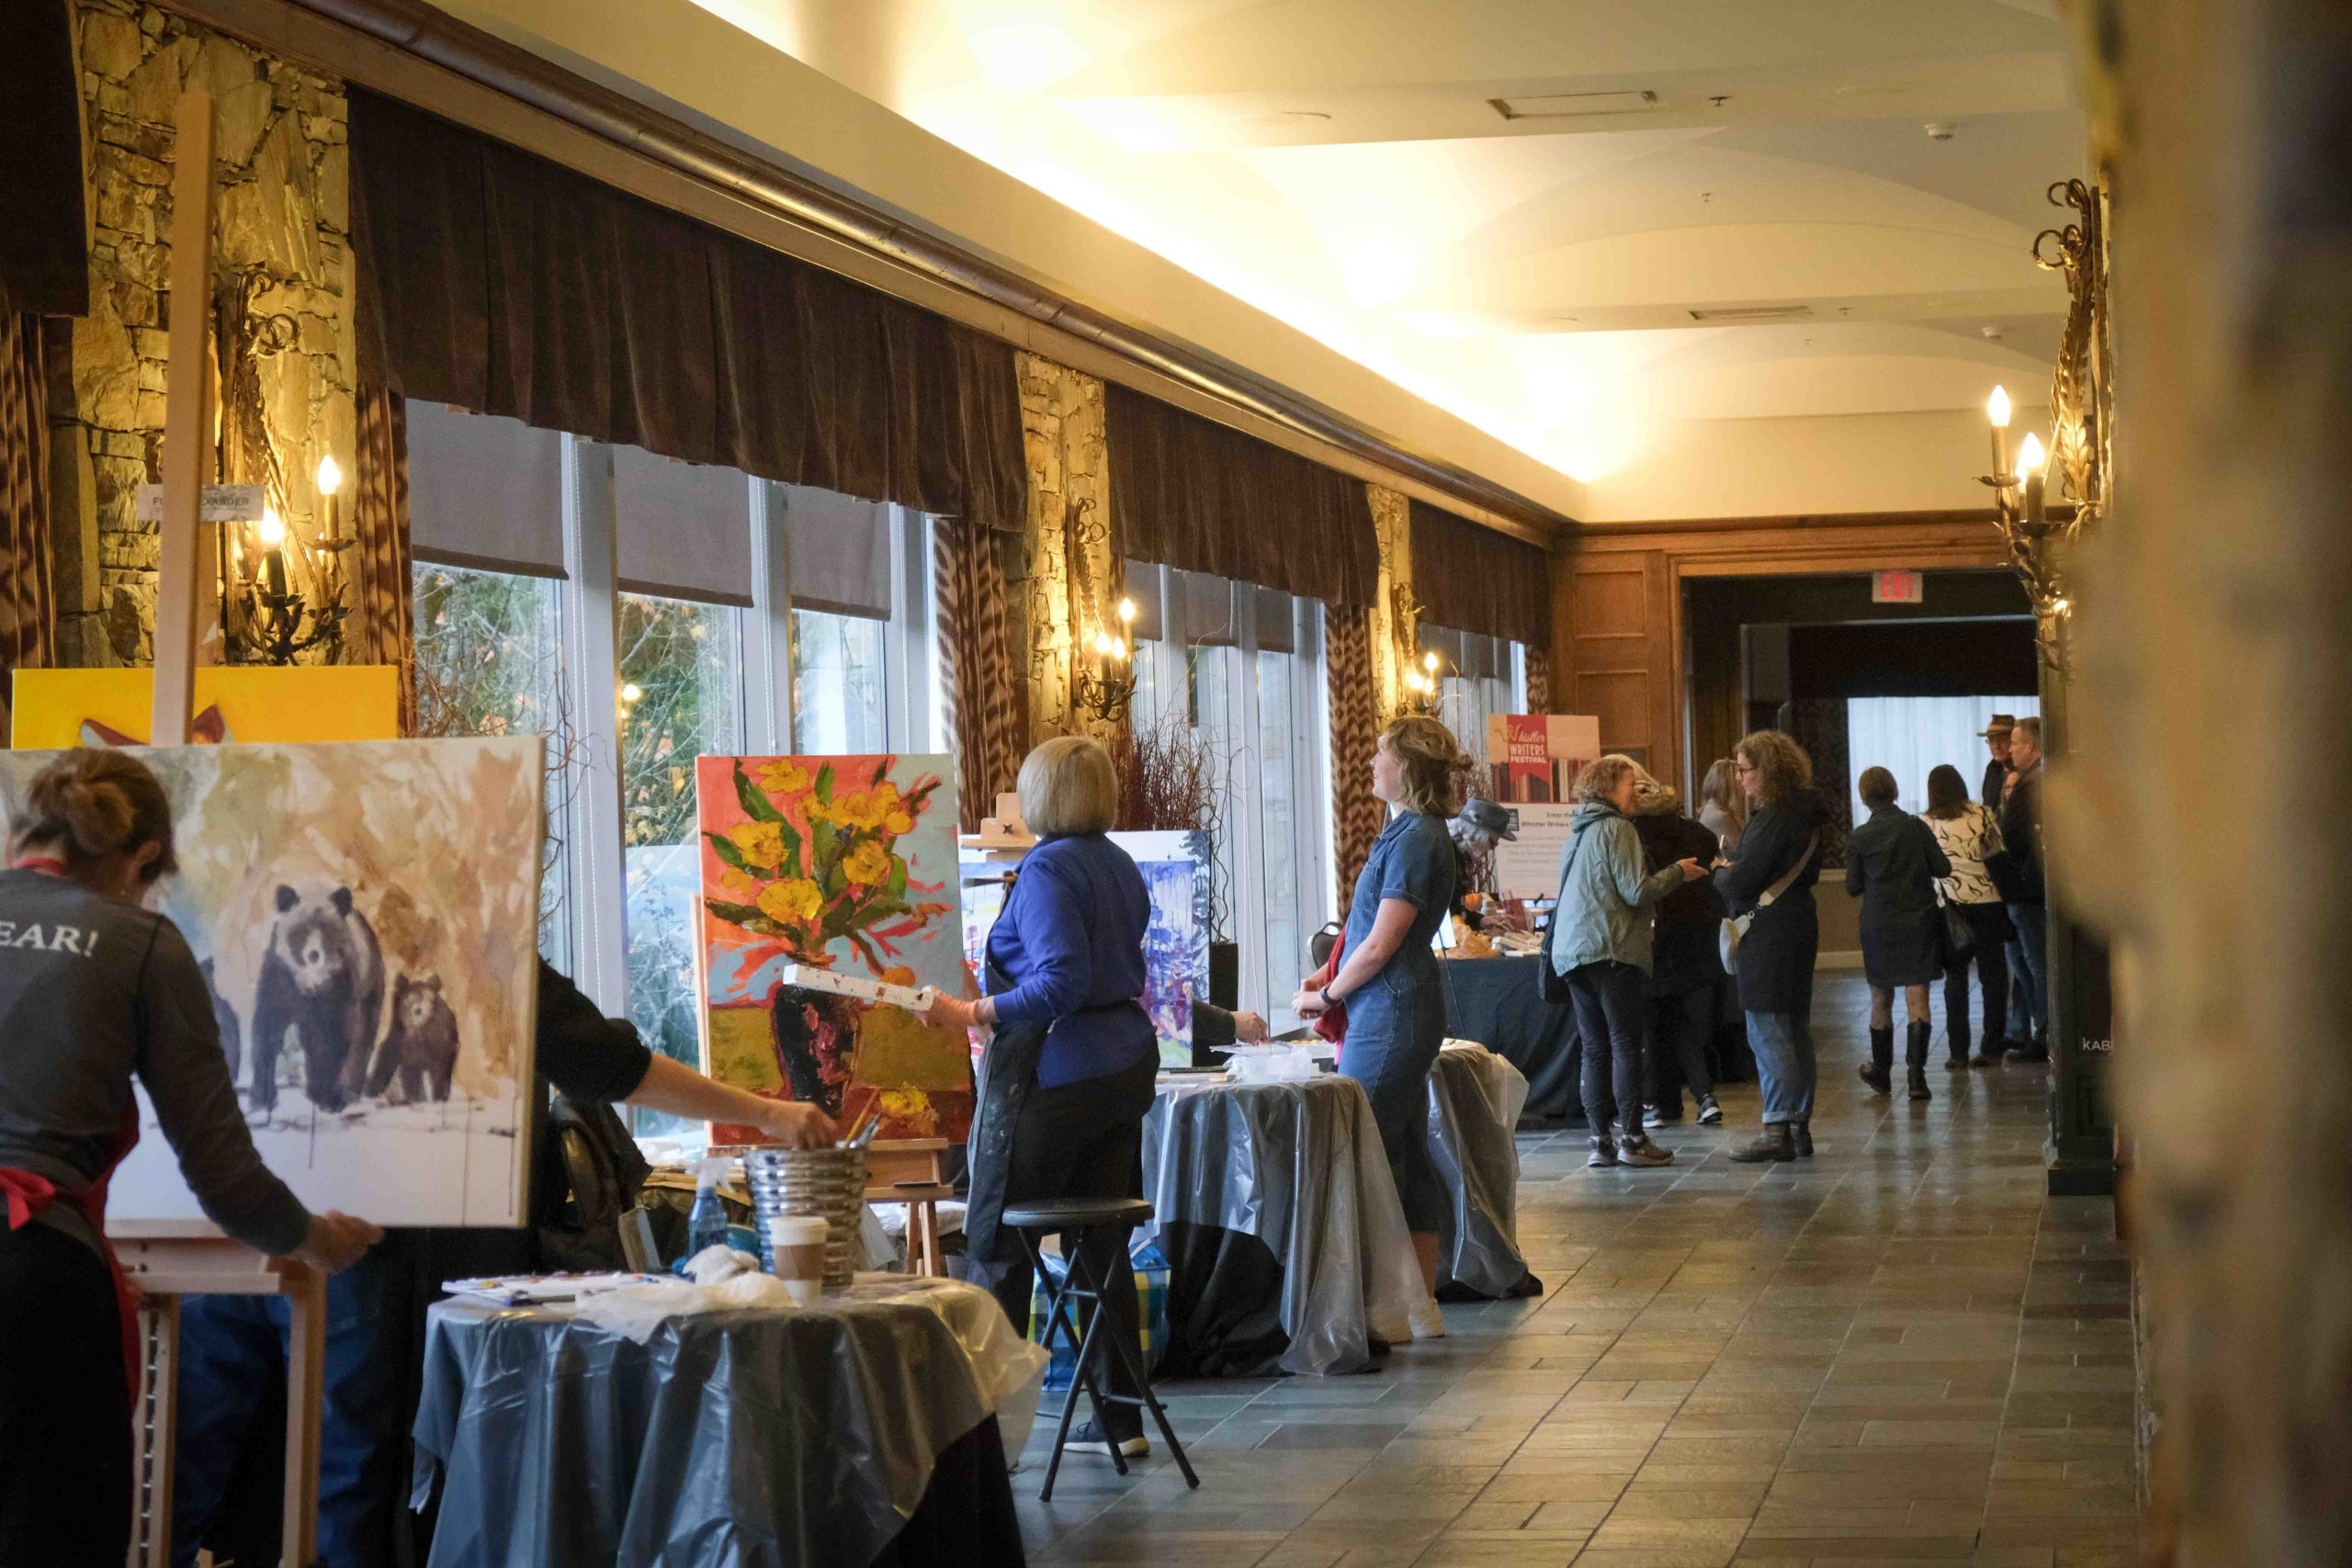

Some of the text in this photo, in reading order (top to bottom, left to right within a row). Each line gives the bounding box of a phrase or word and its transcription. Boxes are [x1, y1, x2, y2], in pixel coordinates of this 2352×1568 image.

[204, 497, 250, 506] XANDER
[1495, 724, 1545, 742] Whistler
[1510, 744, 1544, 756] WRITERS
